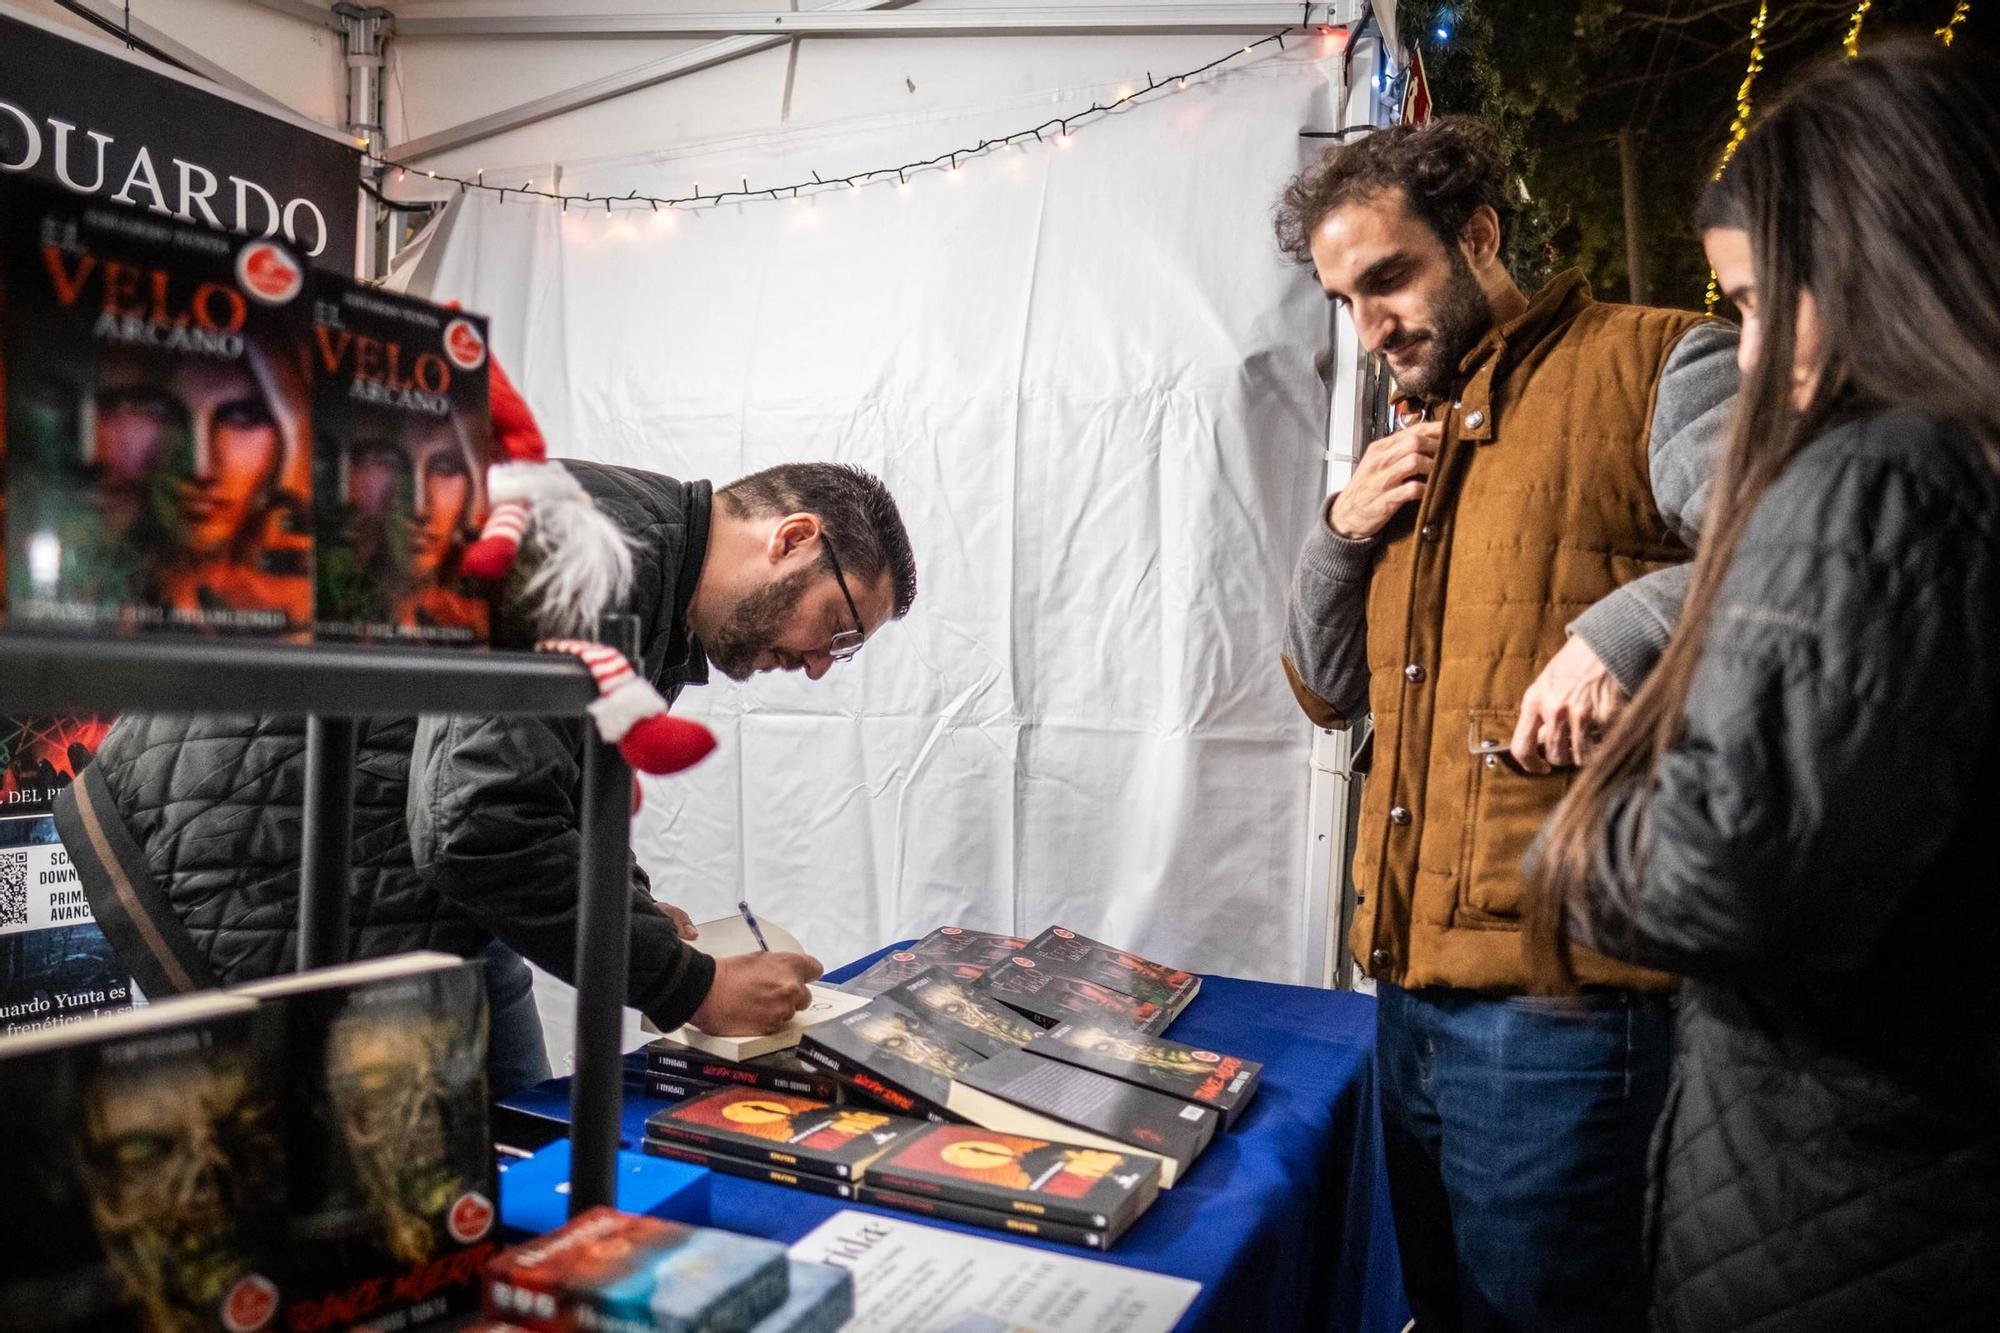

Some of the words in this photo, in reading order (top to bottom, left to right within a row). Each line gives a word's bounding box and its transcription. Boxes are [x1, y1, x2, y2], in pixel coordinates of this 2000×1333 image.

[41, 243, 247, 335] VELO
[95, 311, 245, 359] ARCANO
[313, 321, 450, 396] VELO
[9, 789, 42, 804] DEL
[40, 869, 76, 885] DOWN
[51, 904, 89, 921] AVANC
[55, 990, 105, 1009] Yunta
[109, 986, 126, 999] es
[662, 1056, 687, 1069] TEMPORADA
[660, 1083, 685, 1096] TEMPORADA
